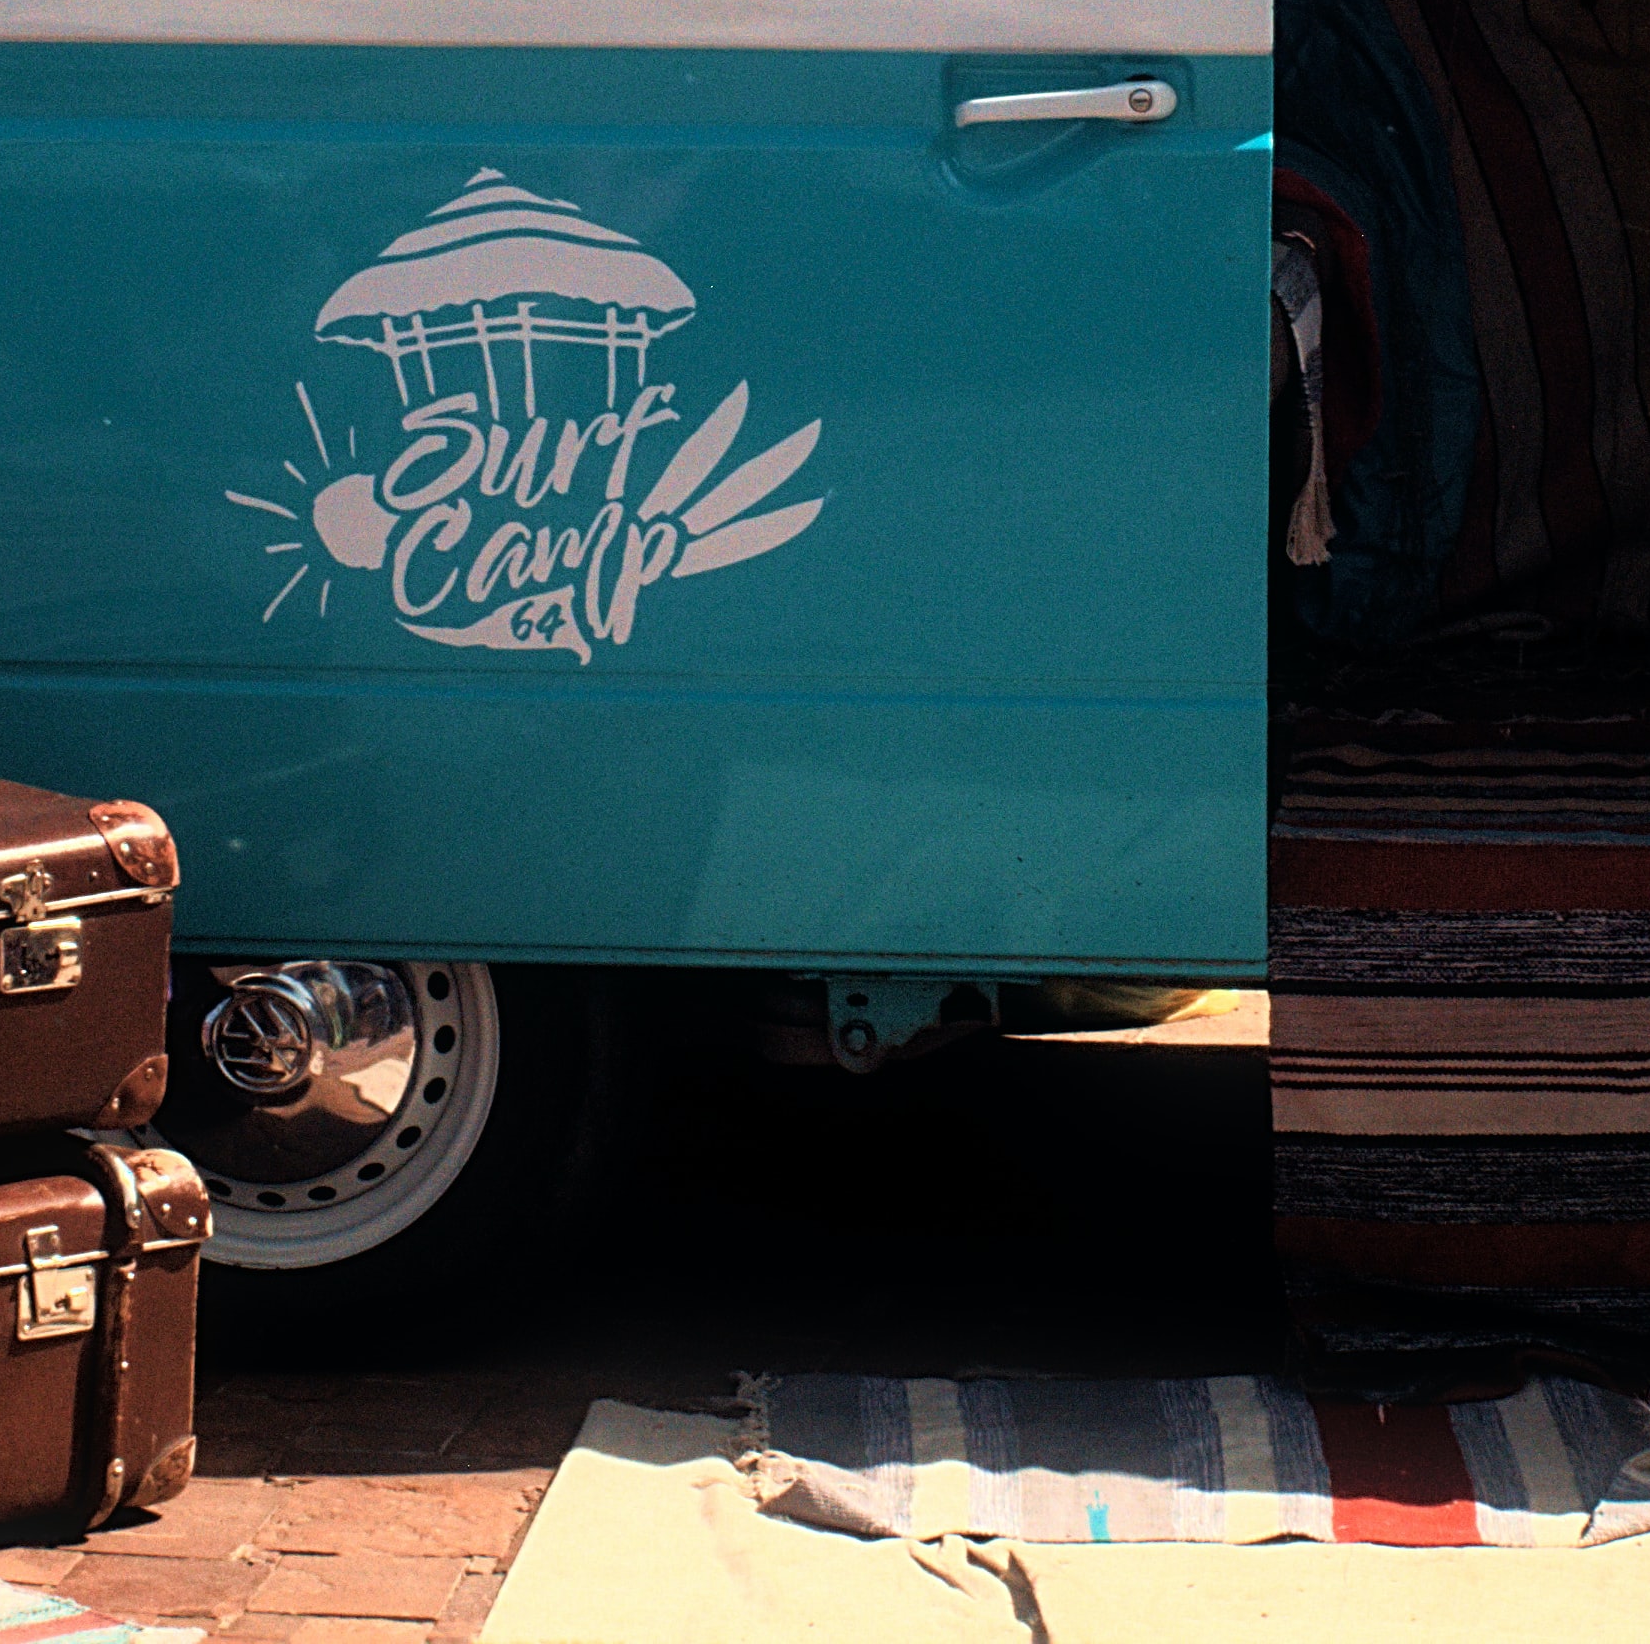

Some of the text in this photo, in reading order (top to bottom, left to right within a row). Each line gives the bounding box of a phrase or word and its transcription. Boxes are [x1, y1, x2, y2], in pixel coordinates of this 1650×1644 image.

[382, 382, 681, 510] Surf
[392, 497, 679, 646] Camp
[508, 601, 565, 643] 64
